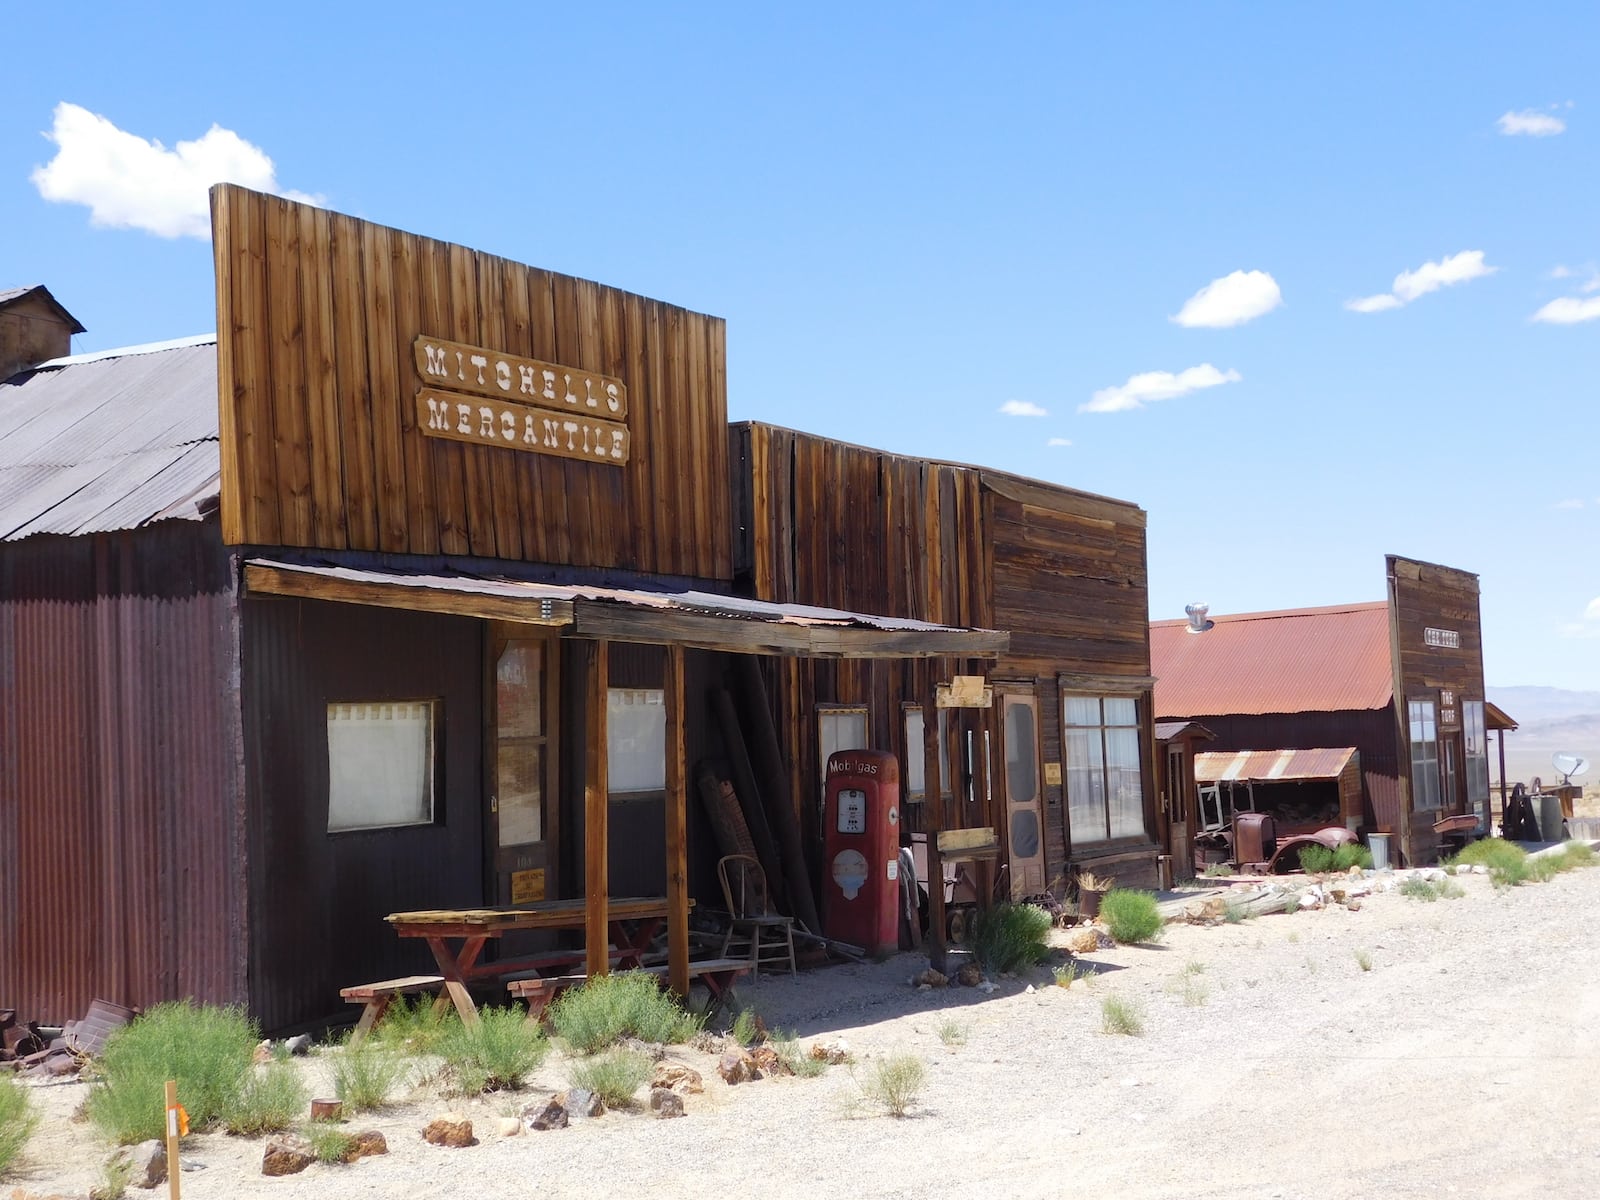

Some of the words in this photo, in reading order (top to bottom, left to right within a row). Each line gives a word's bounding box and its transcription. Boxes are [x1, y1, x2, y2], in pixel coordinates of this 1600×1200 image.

[424, 343, 619, 412] MITCHELL'S
[427, 397, 623, 459] MERCANTILE
[1442, 691, 1453, 705] THE
